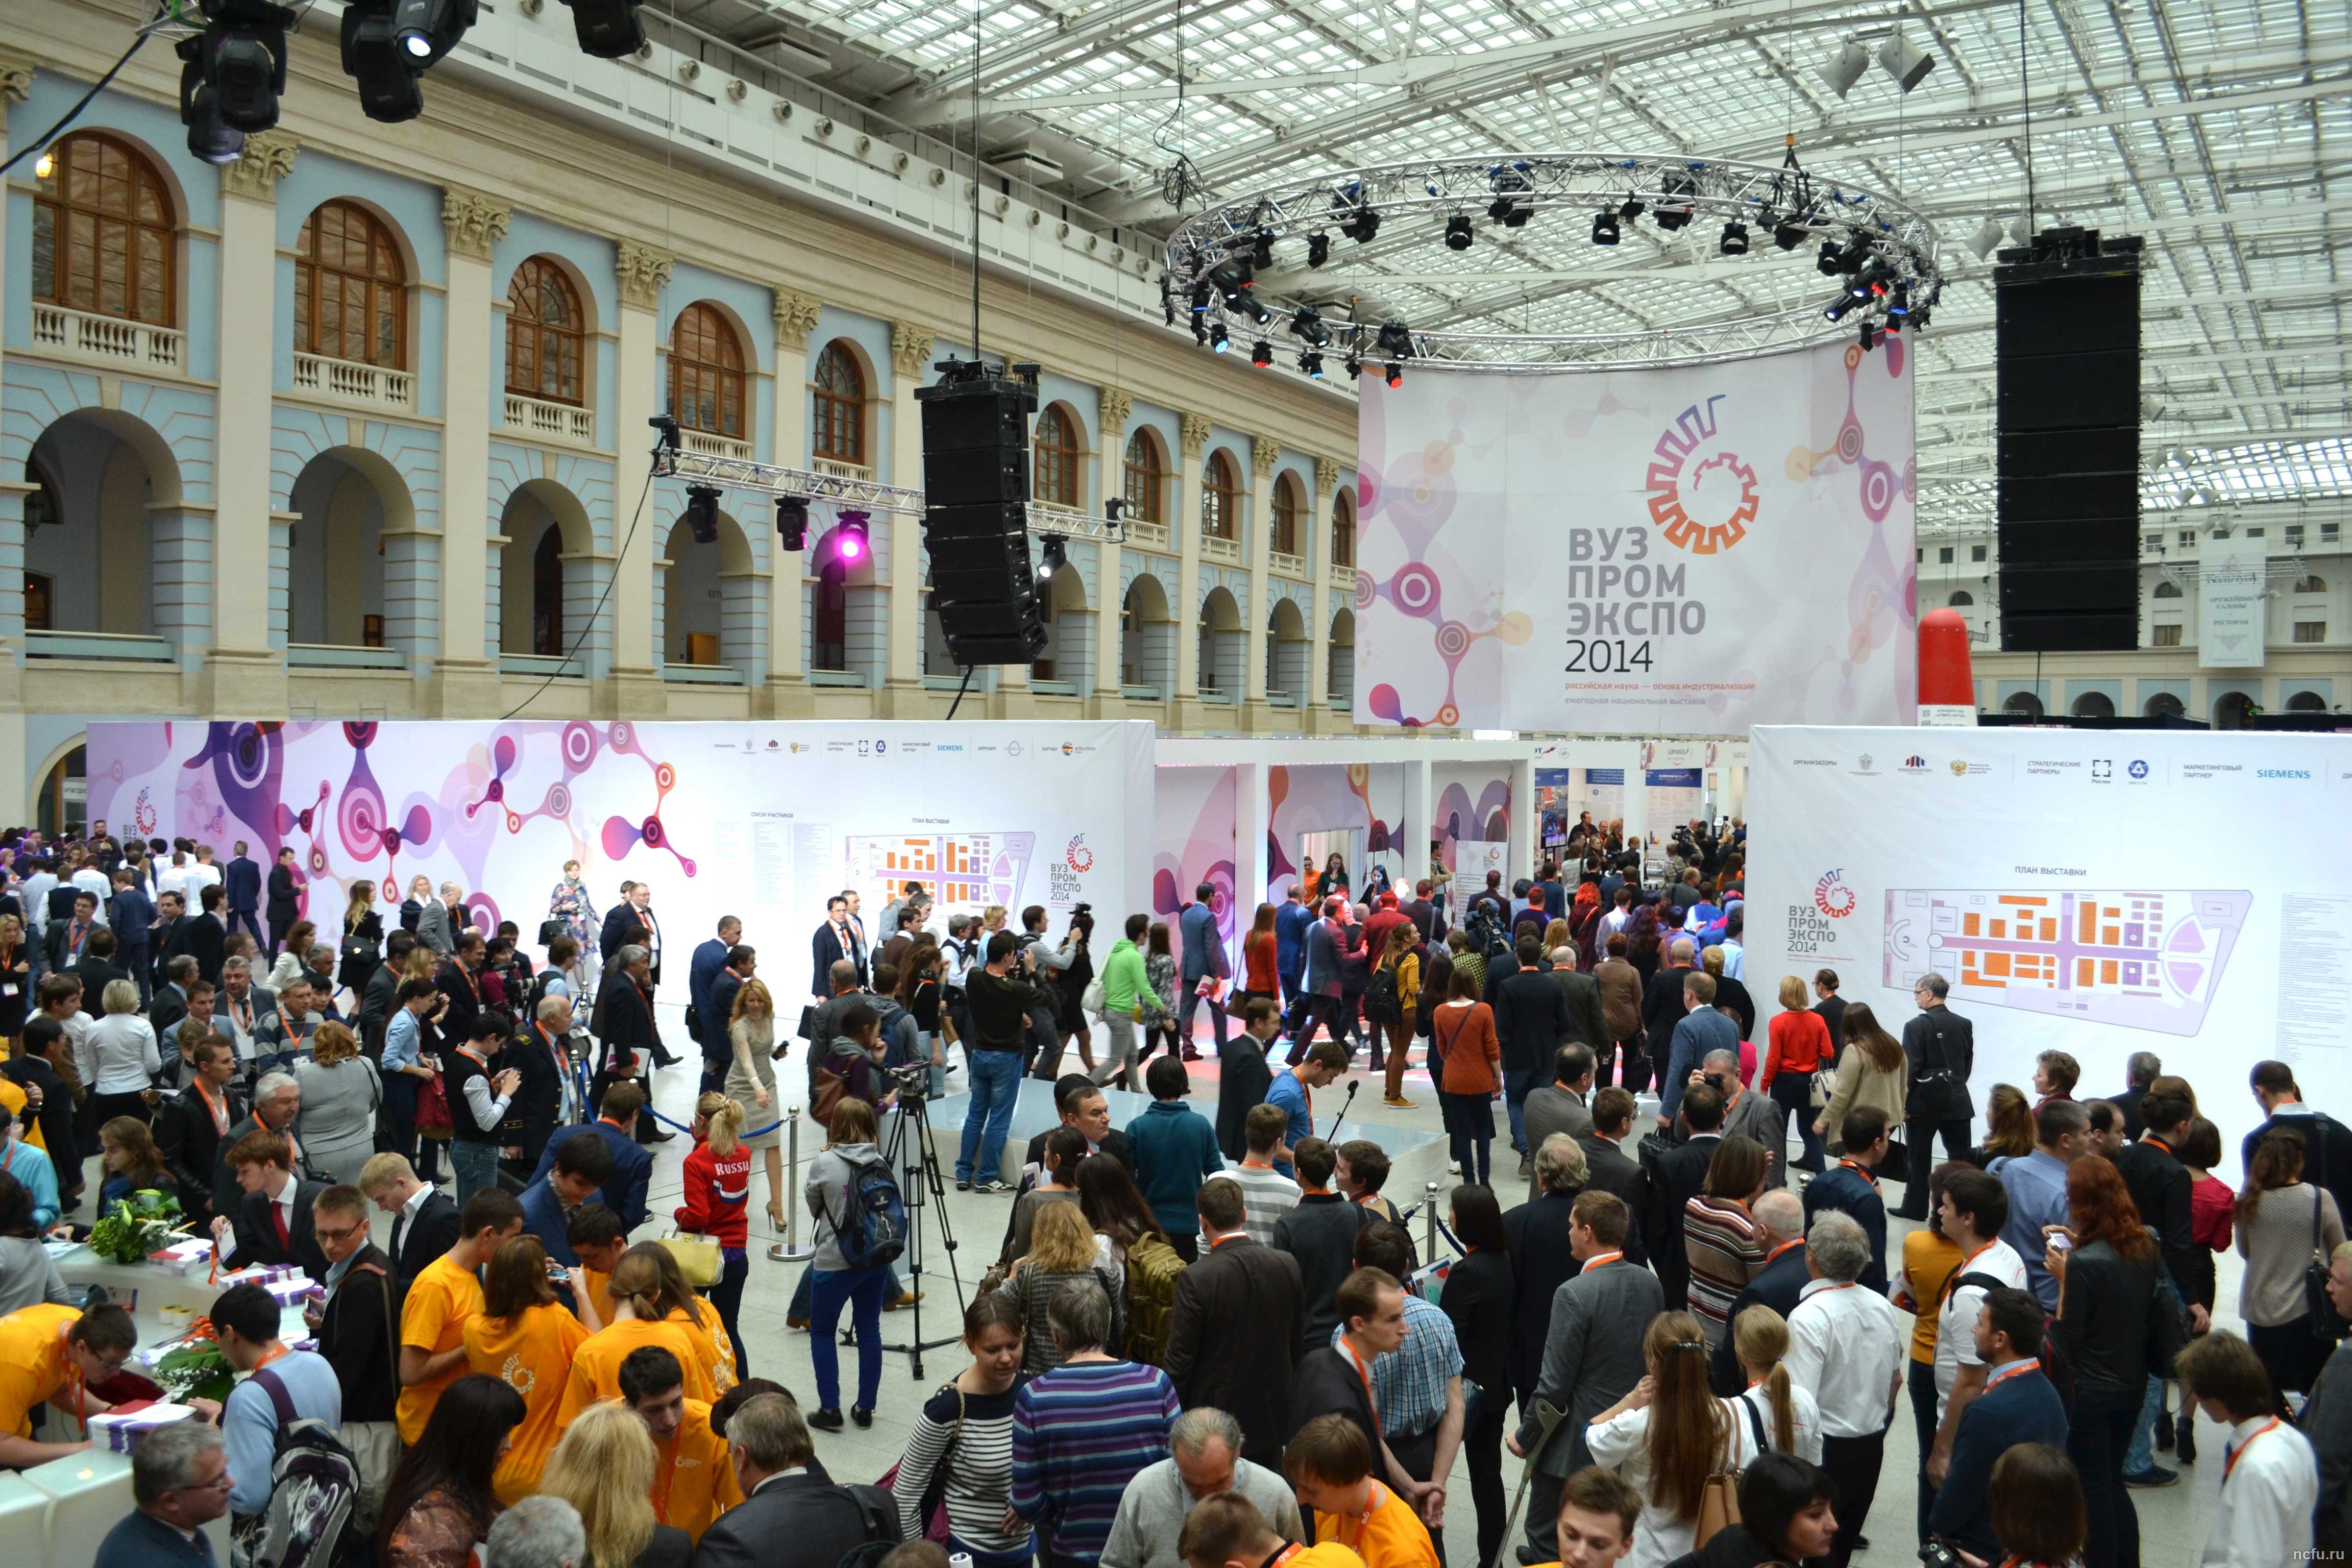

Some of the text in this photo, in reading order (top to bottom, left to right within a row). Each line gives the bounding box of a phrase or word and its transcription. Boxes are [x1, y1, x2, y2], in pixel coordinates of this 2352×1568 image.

[1569, 526, 1648, 561] ВУЗ
[1568, 564, 1685, 598] ПРОМ
[1566, 600, 1706, 635] ЭКСПО
[1565, 640, 1653, 673] 2014
[1565, 681, 1612, 691] российская
[1682, 683, 1755, 692] индустриализации
[2257, 769, 2310, 779] SIEMENS
[123, 824, 137, 836] ВУЗ
[1051, 864, 1068, 873] ВУЗ
[2041, 867, 2087, 876] ВЫСТАВКИ
[1050, 873, 1076, 883] ПРОМ
[1050, 882, 1081, 892] ЭКСПО
[1050, 891, 1070, 901] 2014
[1789, 905, 1816, 917] ВУЗ
[1788, 917, 1829, 930] ПРОМ
[1788, 929, 1836, 942] ЭКСПО
[1787, 940, 1818, 953] 2014
